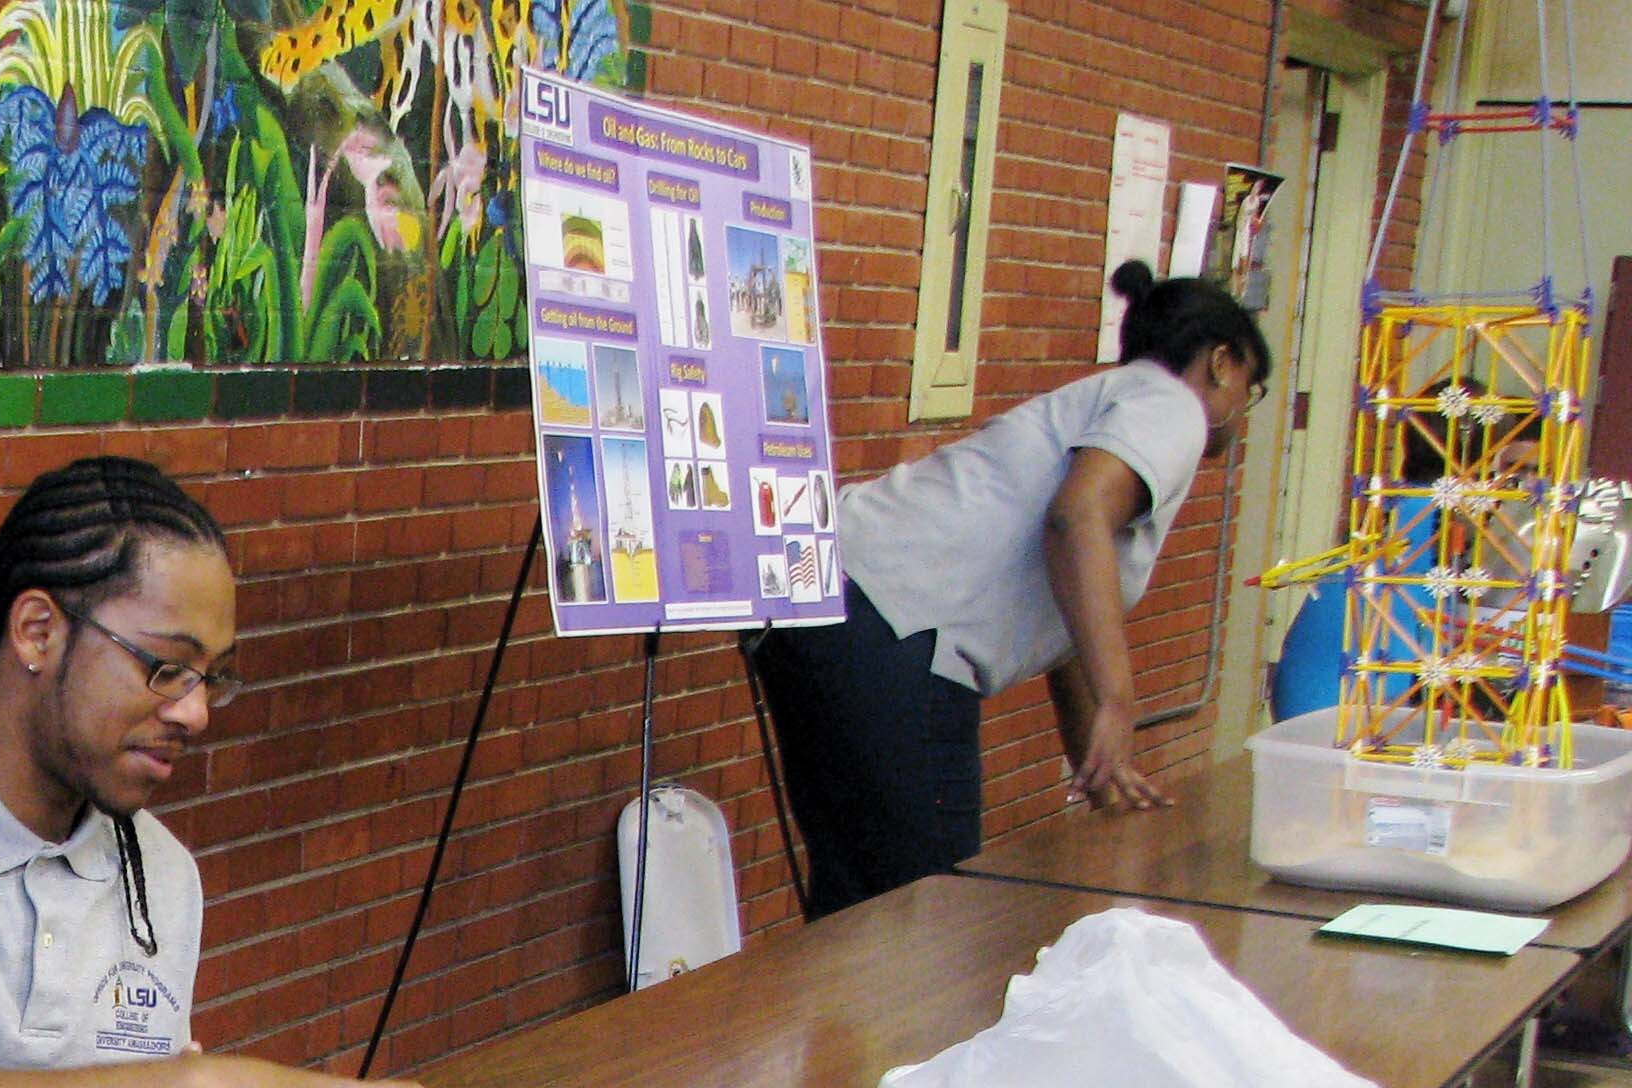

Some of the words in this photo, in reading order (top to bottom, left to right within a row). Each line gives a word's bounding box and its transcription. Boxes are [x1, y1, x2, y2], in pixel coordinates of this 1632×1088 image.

[524, 77, 570, 131] LSU
[602, 115, 617, 138] Oil
[618, 123, 635, 143] and
[636, 127, 659, 148] Gas:
[660, 132, 687, 155] From
[687, 138, 715, 162] Rocks
[716, 146, 726, 165] to
[727, 148, 747, 170] Cars
[537, 149, 563, 172] Where
[563, 156, 574, 175] do
[541, 307, 568, 328] Getting
[578, 312, 596, 329] from
[127, 986, 157, 1008] LSU
